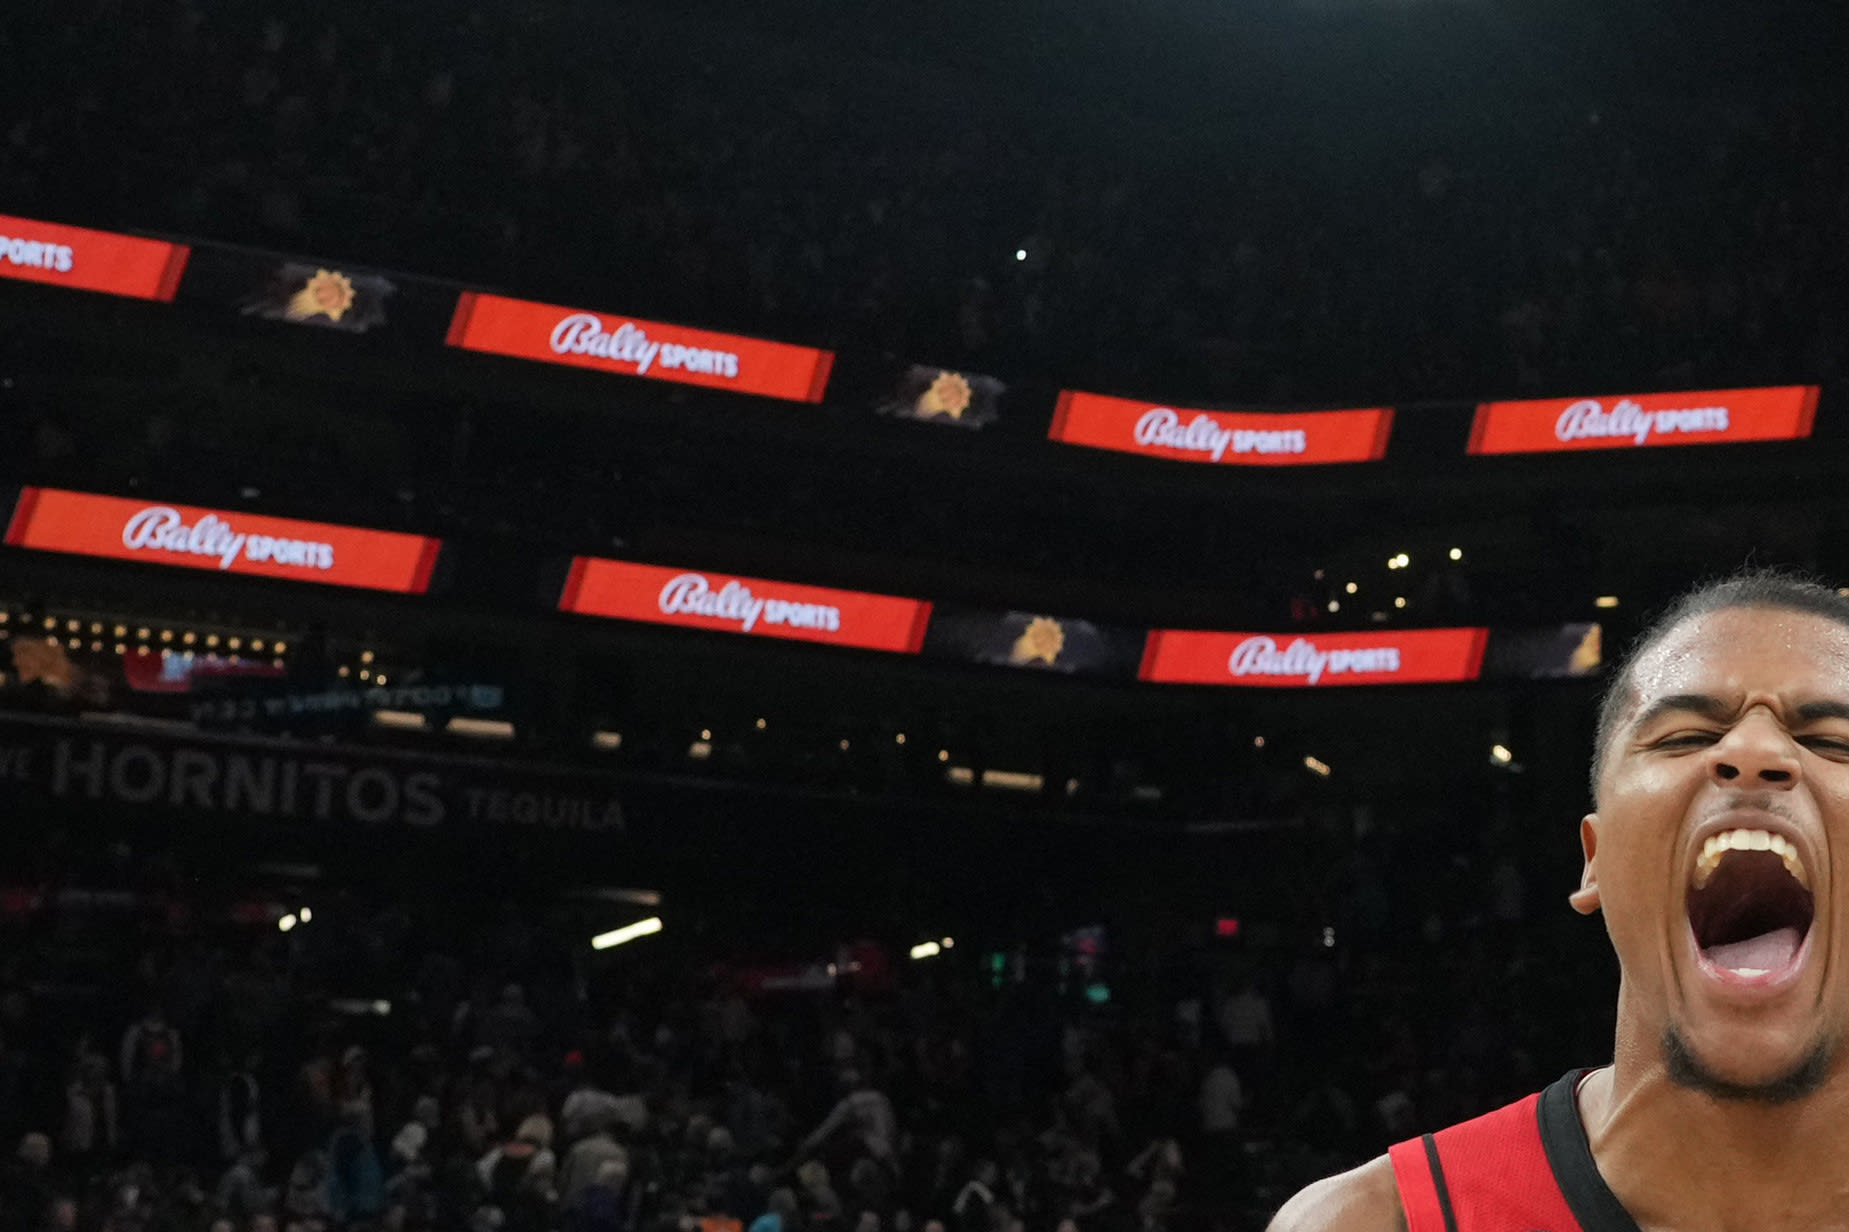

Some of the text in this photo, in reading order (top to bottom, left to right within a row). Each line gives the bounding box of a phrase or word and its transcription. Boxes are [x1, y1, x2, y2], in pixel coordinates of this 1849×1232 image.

[549, 312, 738, 378] Bally SPORTS
[1134, 407, 1307, 462] Bally SPORTS
[1554, 398, 1730, 445] Bally SPORTS
[122, 506, 335, 570] Bally SPORTS
[658, 573, 841, 633] Bally SPORTS
[1228, 635, 1401, 685] Bally SPORTS
[52, 738, 446, 827] HORNITOS
[466, 788, 626, 832] TEQUILA
